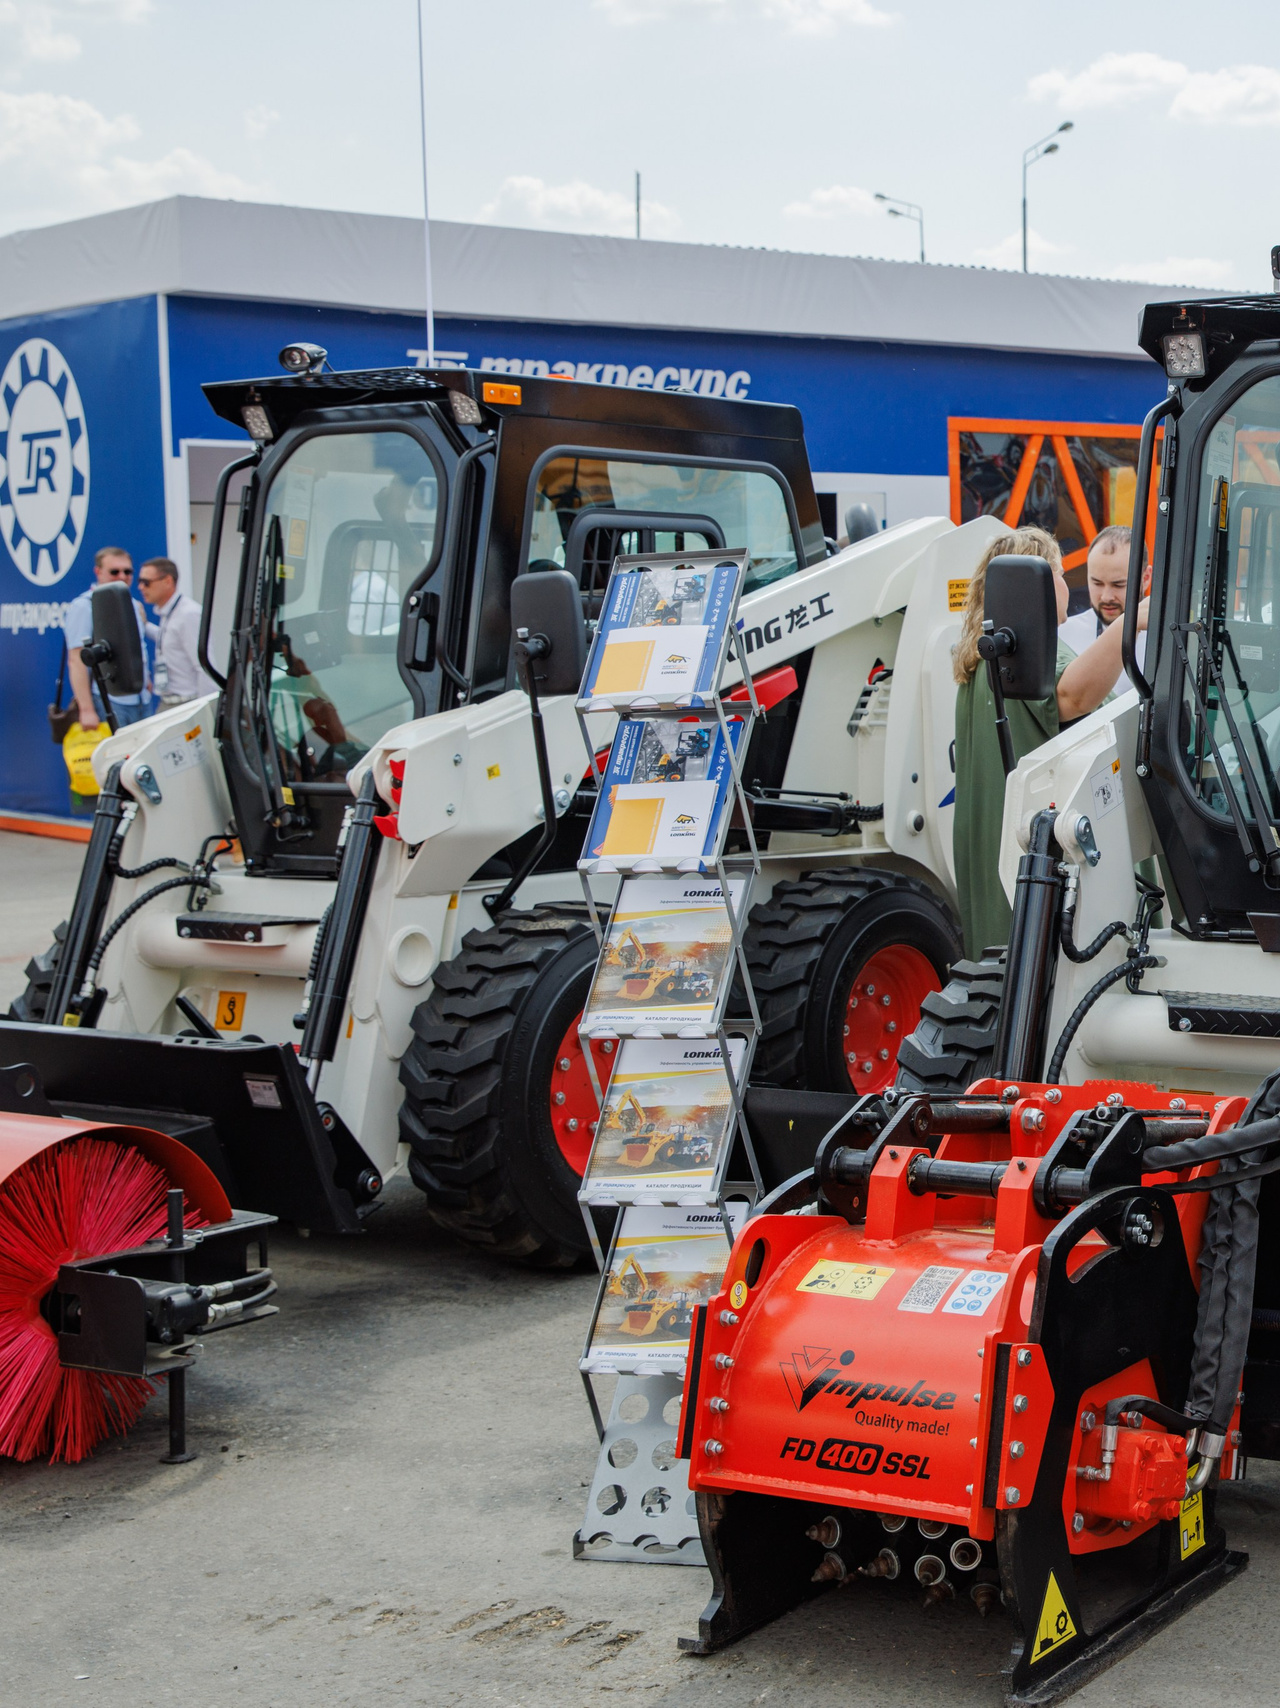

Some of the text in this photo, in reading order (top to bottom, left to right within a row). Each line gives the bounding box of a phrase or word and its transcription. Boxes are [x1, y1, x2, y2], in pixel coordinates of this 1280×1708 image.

[855, 1410, 950, 1436] Quality made!
[780, 1437, 931, 1480] FD 400 SSL
